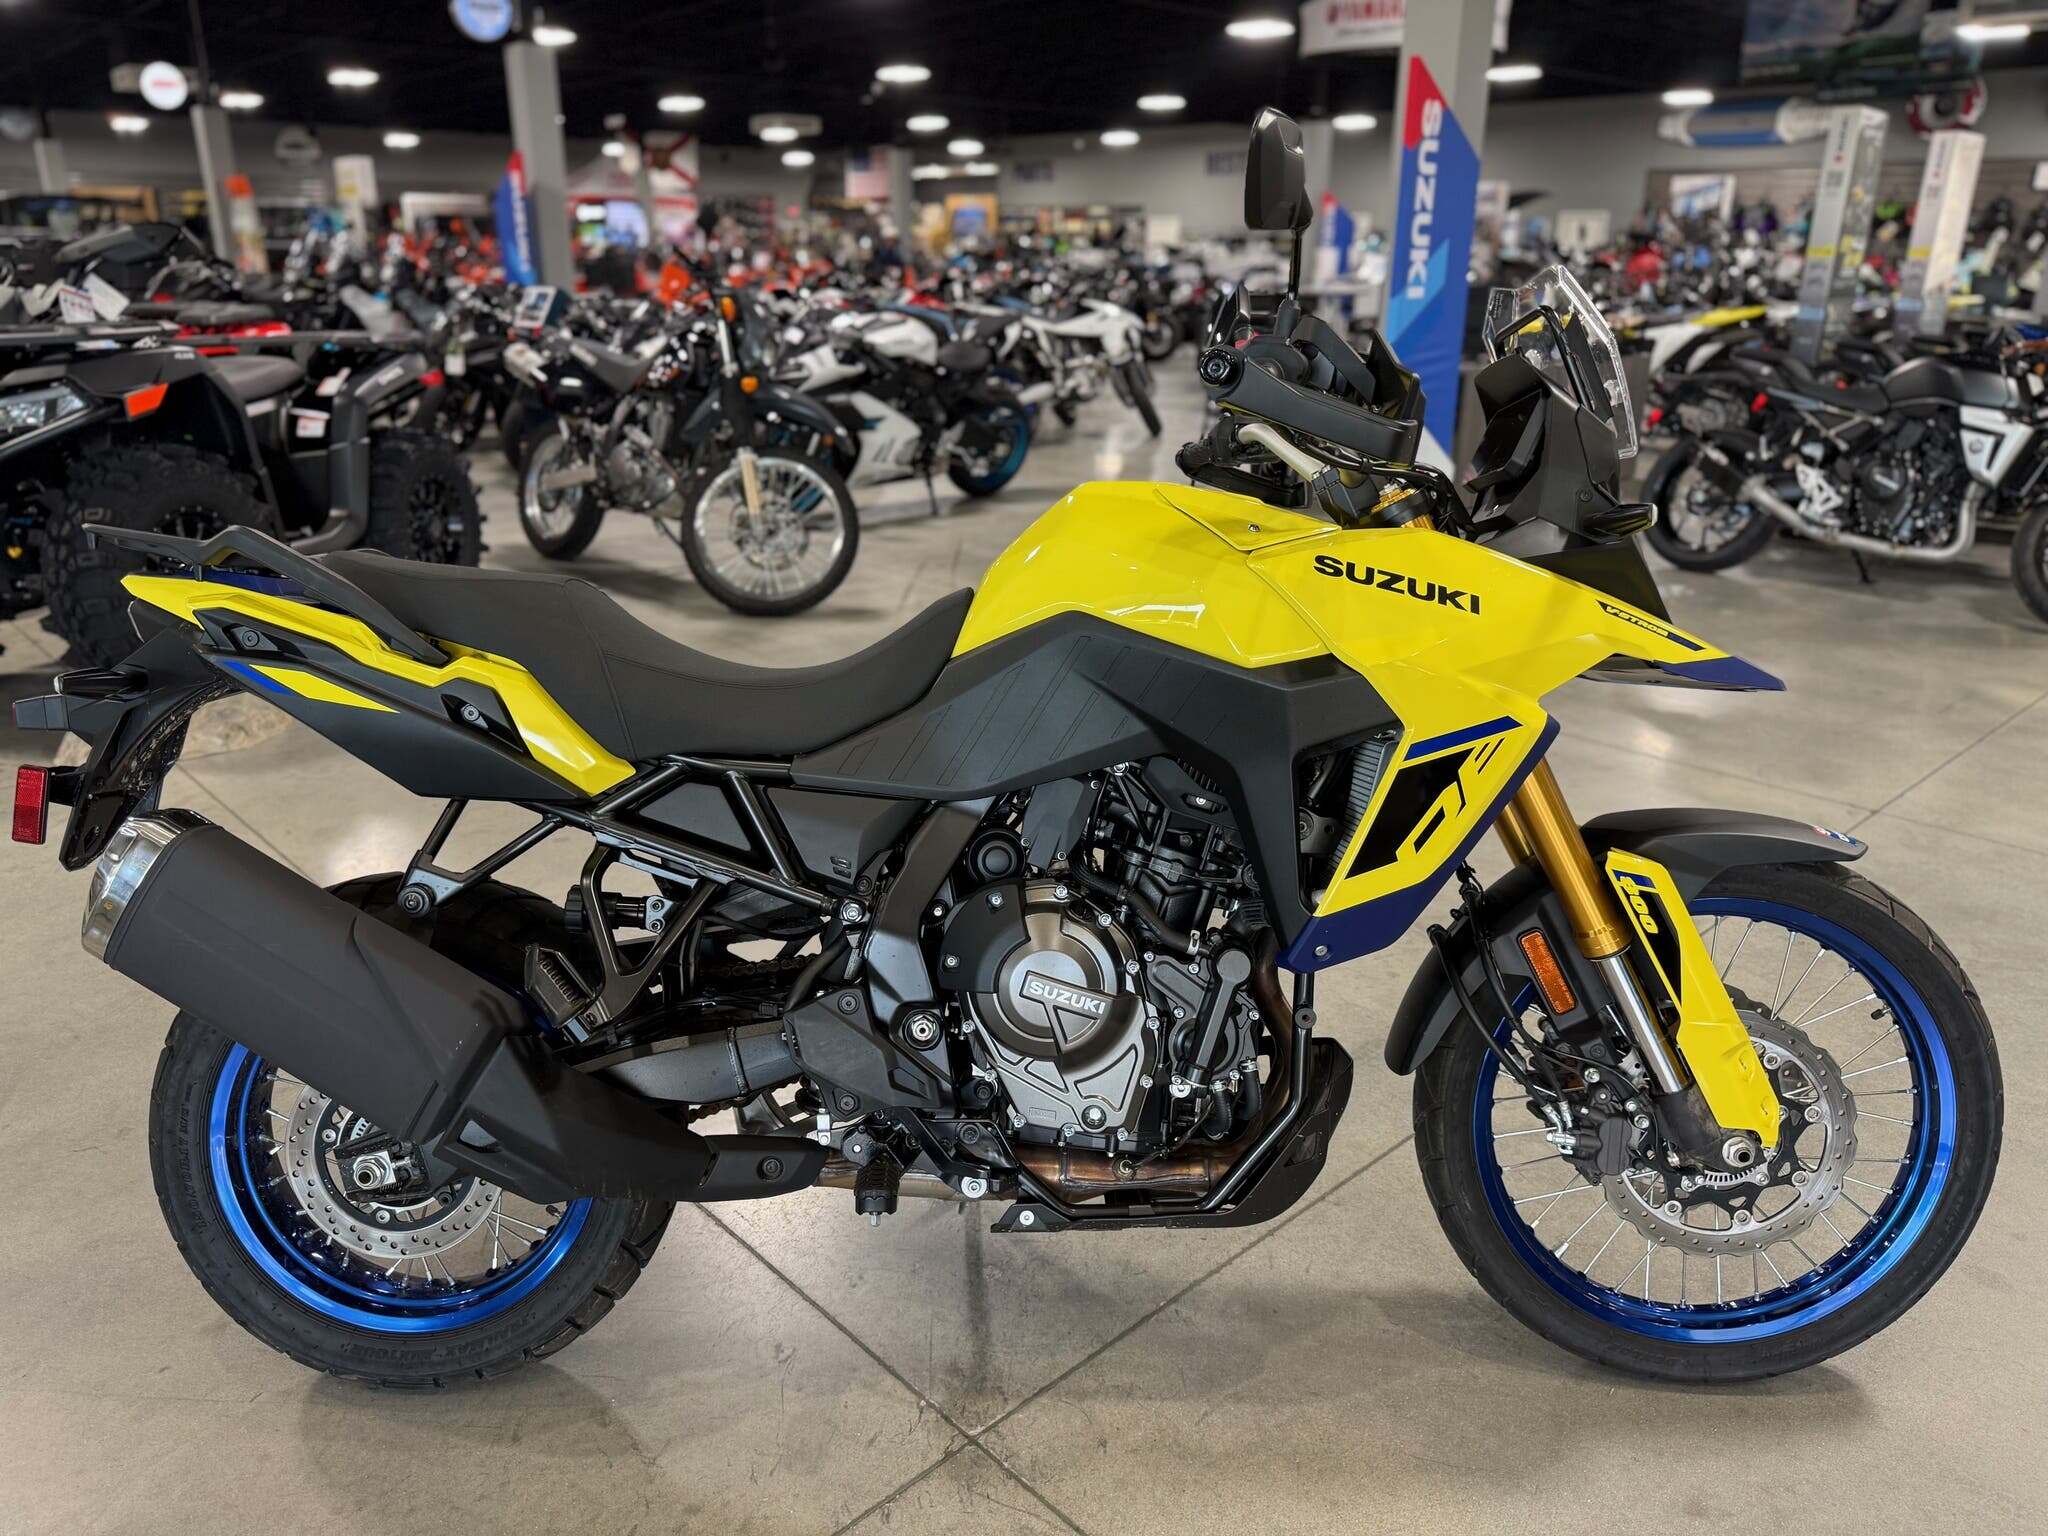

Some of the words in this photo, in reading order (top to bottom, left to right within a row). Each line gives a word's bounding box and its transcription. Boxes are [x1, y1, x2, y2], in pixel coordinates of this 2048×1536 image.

[1406, 98, 1443, 299] SUZUKI
[1313, 555, 1480, 615] SUZUKI
[1618, 876, 1659, 934] 800
[1029, 981, 1106, 1014] SUZUKI
